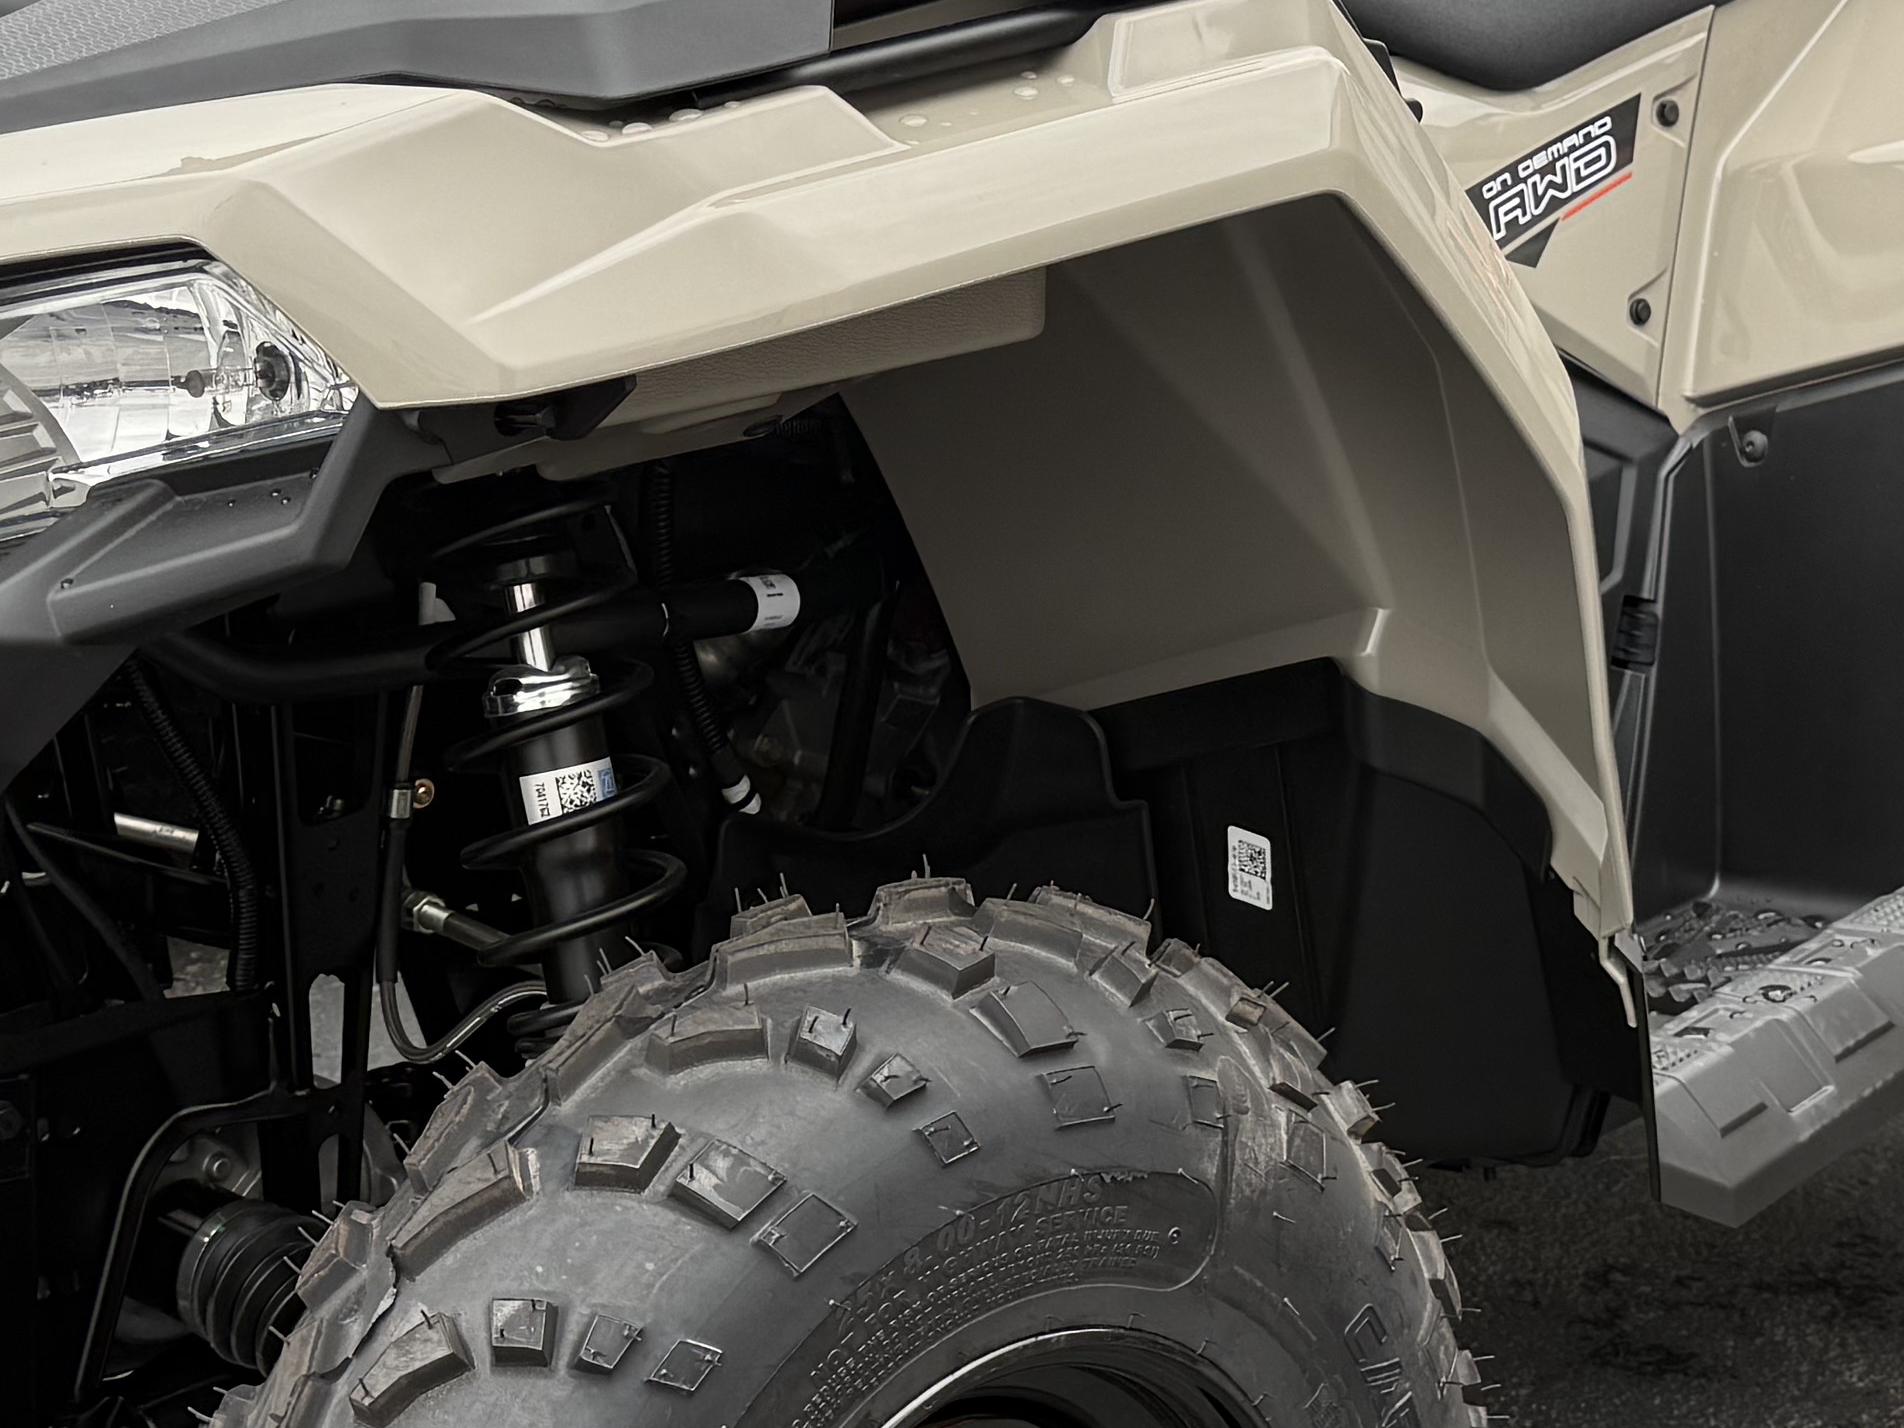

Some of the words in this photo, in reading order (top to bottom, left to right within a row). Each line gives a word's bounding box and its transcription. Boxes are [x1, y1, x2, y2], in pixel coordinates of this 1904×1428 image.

[1481, 172, 1513, 200] ON
[1517, 115, 1613, 179] DEMAND
[1488, 134, 1618, 241] AWD
[1035, 1205, 1128, 1237] SERVICE
